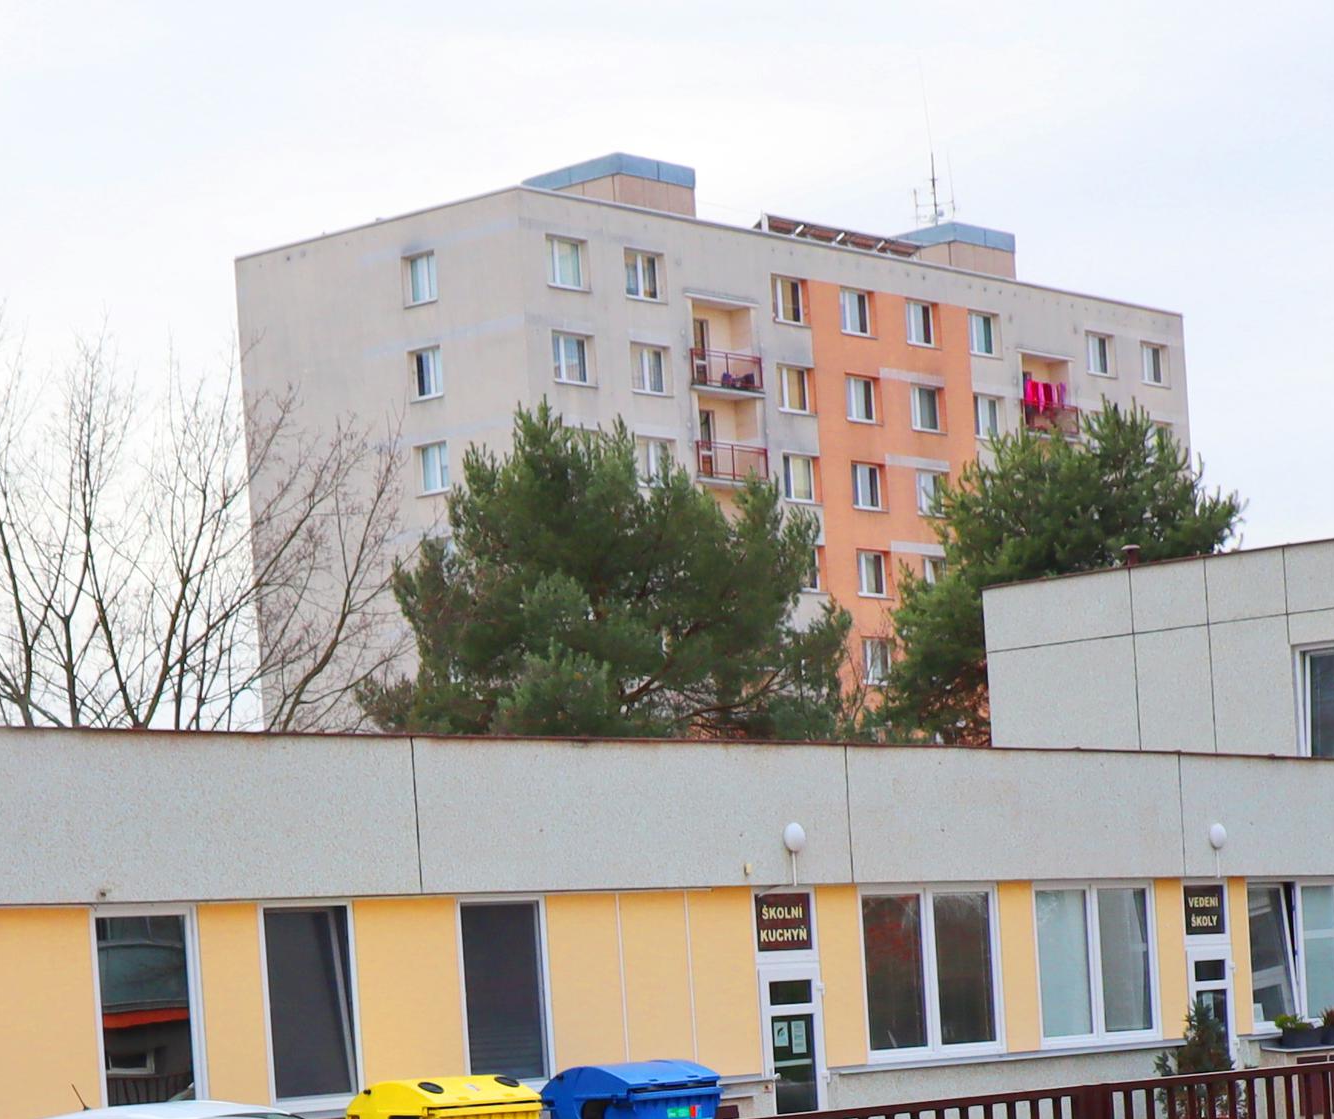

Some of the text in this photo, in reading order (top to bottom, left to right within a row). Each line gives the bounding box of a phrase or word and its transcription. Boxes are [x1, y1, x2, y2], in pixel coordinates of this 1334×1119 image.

[1188, 894, 1219, 908] VEDENÍ
[761, 903, 803, 920] ŠKOLNÍ
[1191, 913, 1218, 927] ŠKOLY
[760, 925, 807, 942] KUCHYŇ
